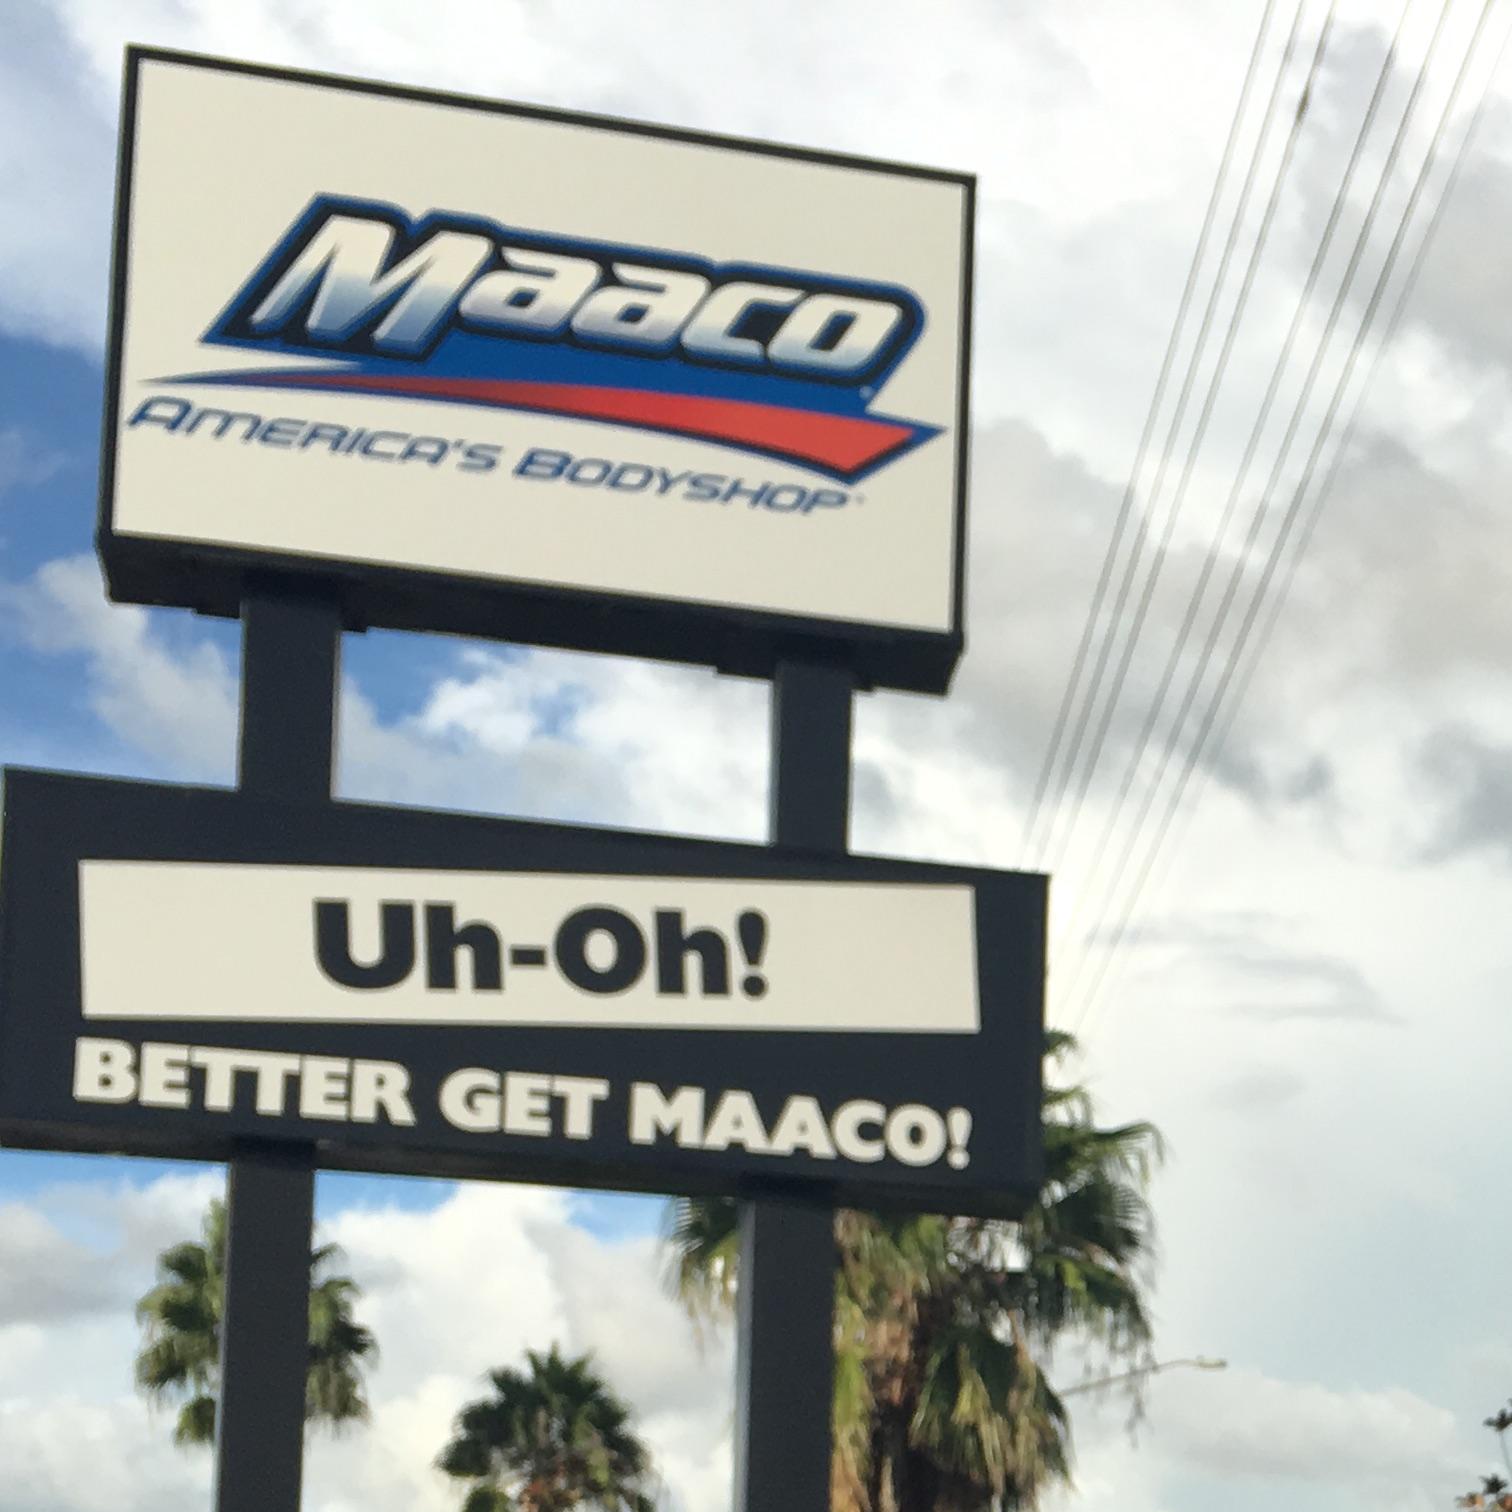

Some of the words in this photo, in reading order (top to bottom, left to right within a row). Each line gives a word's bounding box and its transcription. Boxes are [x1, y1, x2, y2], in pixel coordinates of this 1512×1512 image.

[248, 212, 903, 372] Maaco
[128, 395, 502, 473] AMERICA'S
[512, 446, 848, 515] BODYSHOP
[314, 898, 769, 998] Uh-Oh!
[73, 1037, 415, 1126] BETTER
[439, 1068, 608, 1140] GET
[629, 1084, 971, 1170] MAACO!
